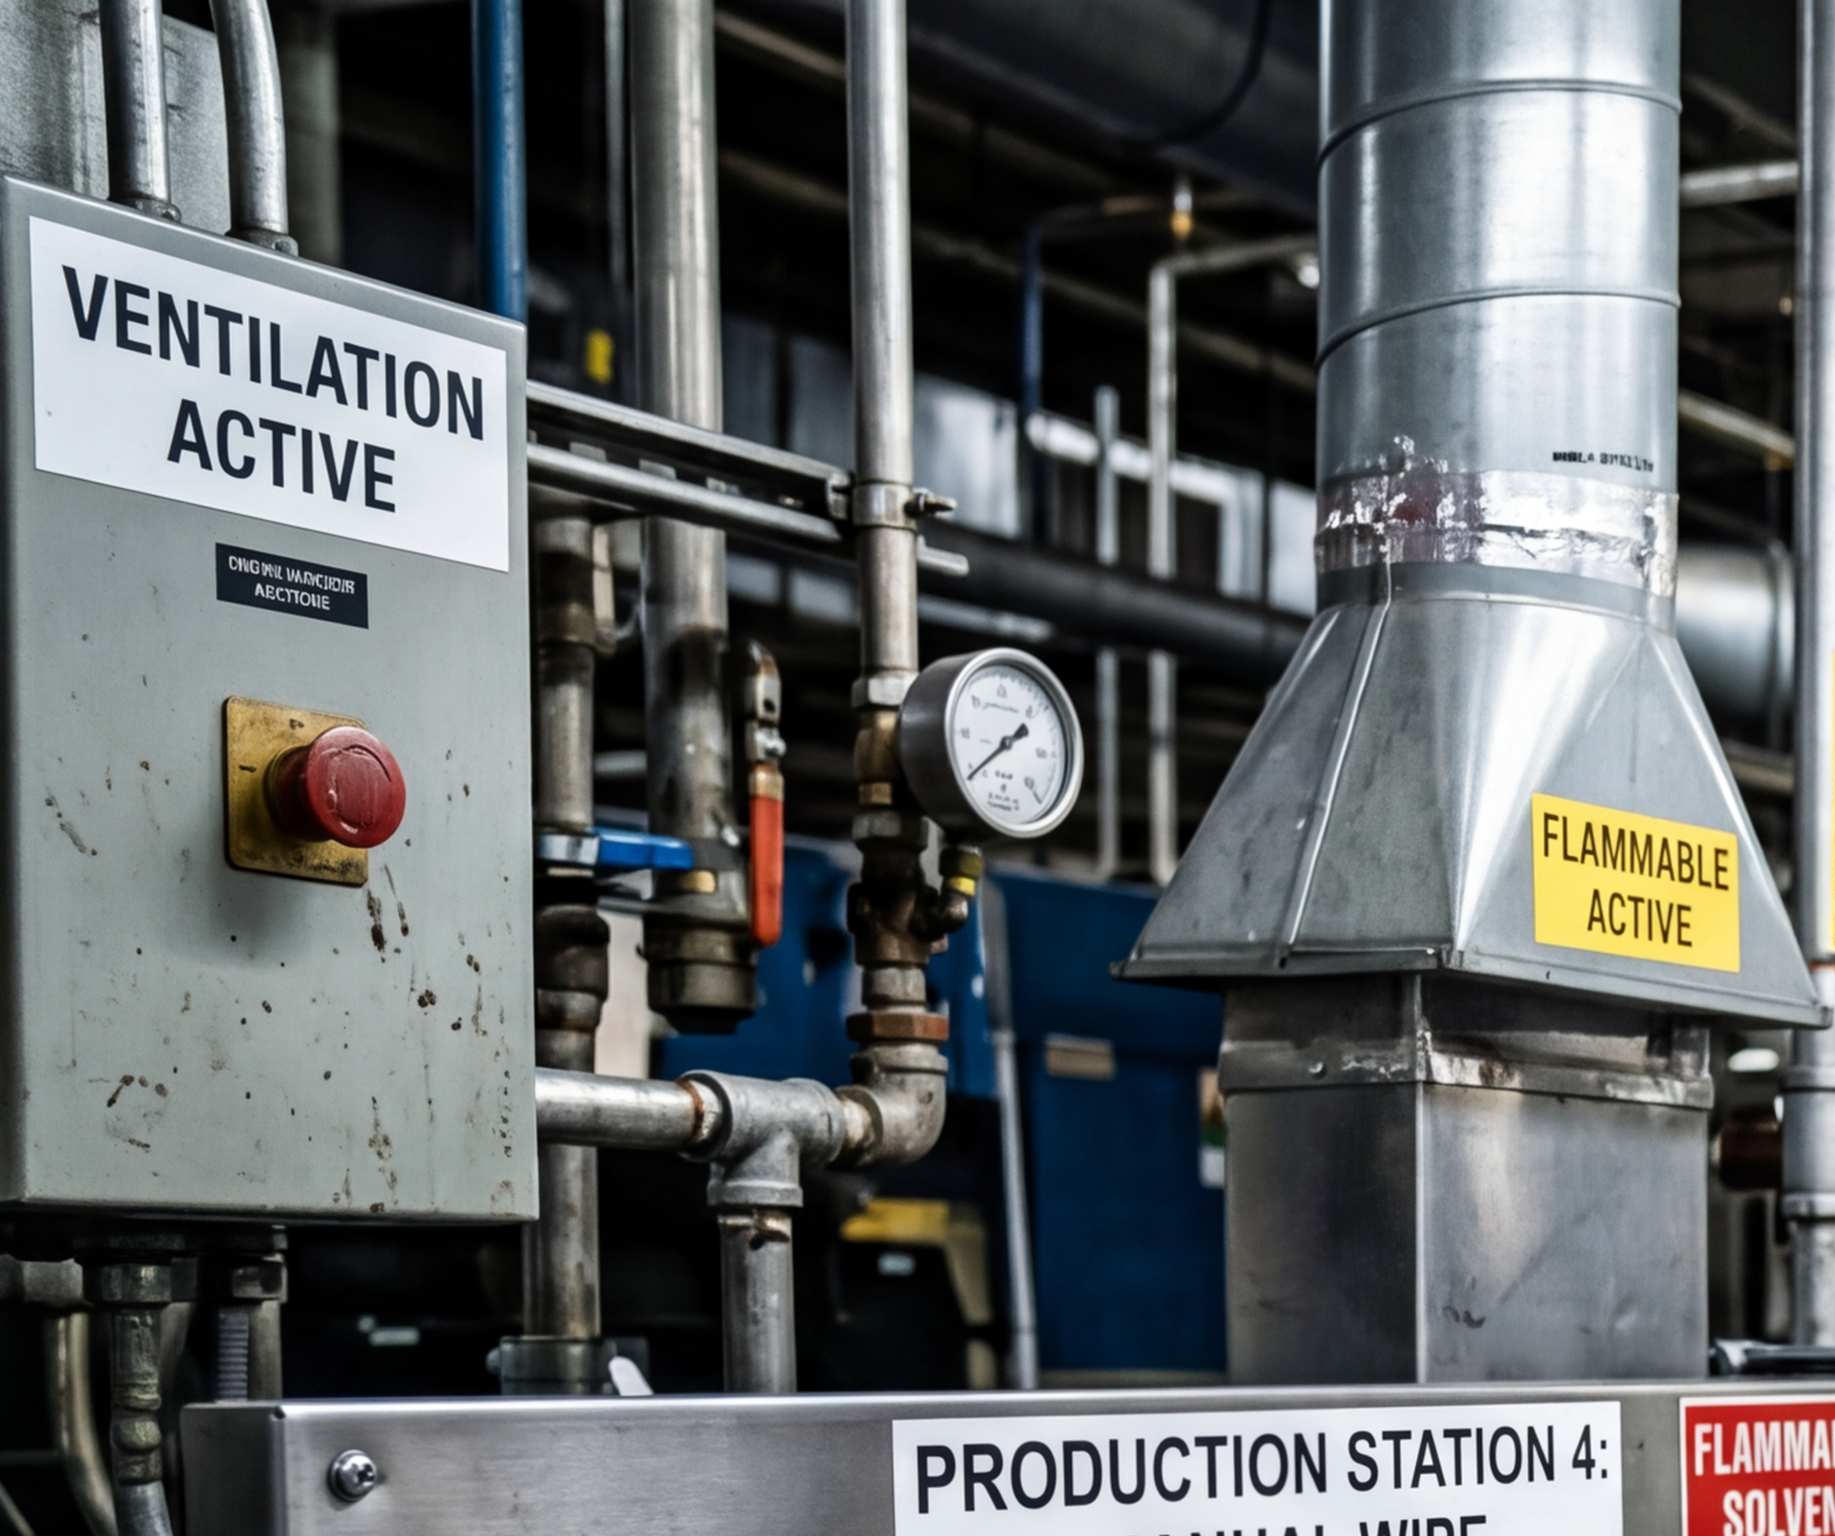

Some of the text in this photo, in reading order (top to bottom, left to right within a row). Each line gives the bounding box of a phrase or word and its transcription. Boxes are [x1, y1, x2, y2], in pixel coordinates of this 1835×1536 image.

[62, 265, 486, 442] VENTILATION
[166, 398, 398, 513] ACTIVE
[1543, 812, 1730, 891] FLAMMABLE
[1587, 888, 1693, 948] ACTIVE
[916, 1424, 1608, 1515] PRODUCTION STATION 4:
